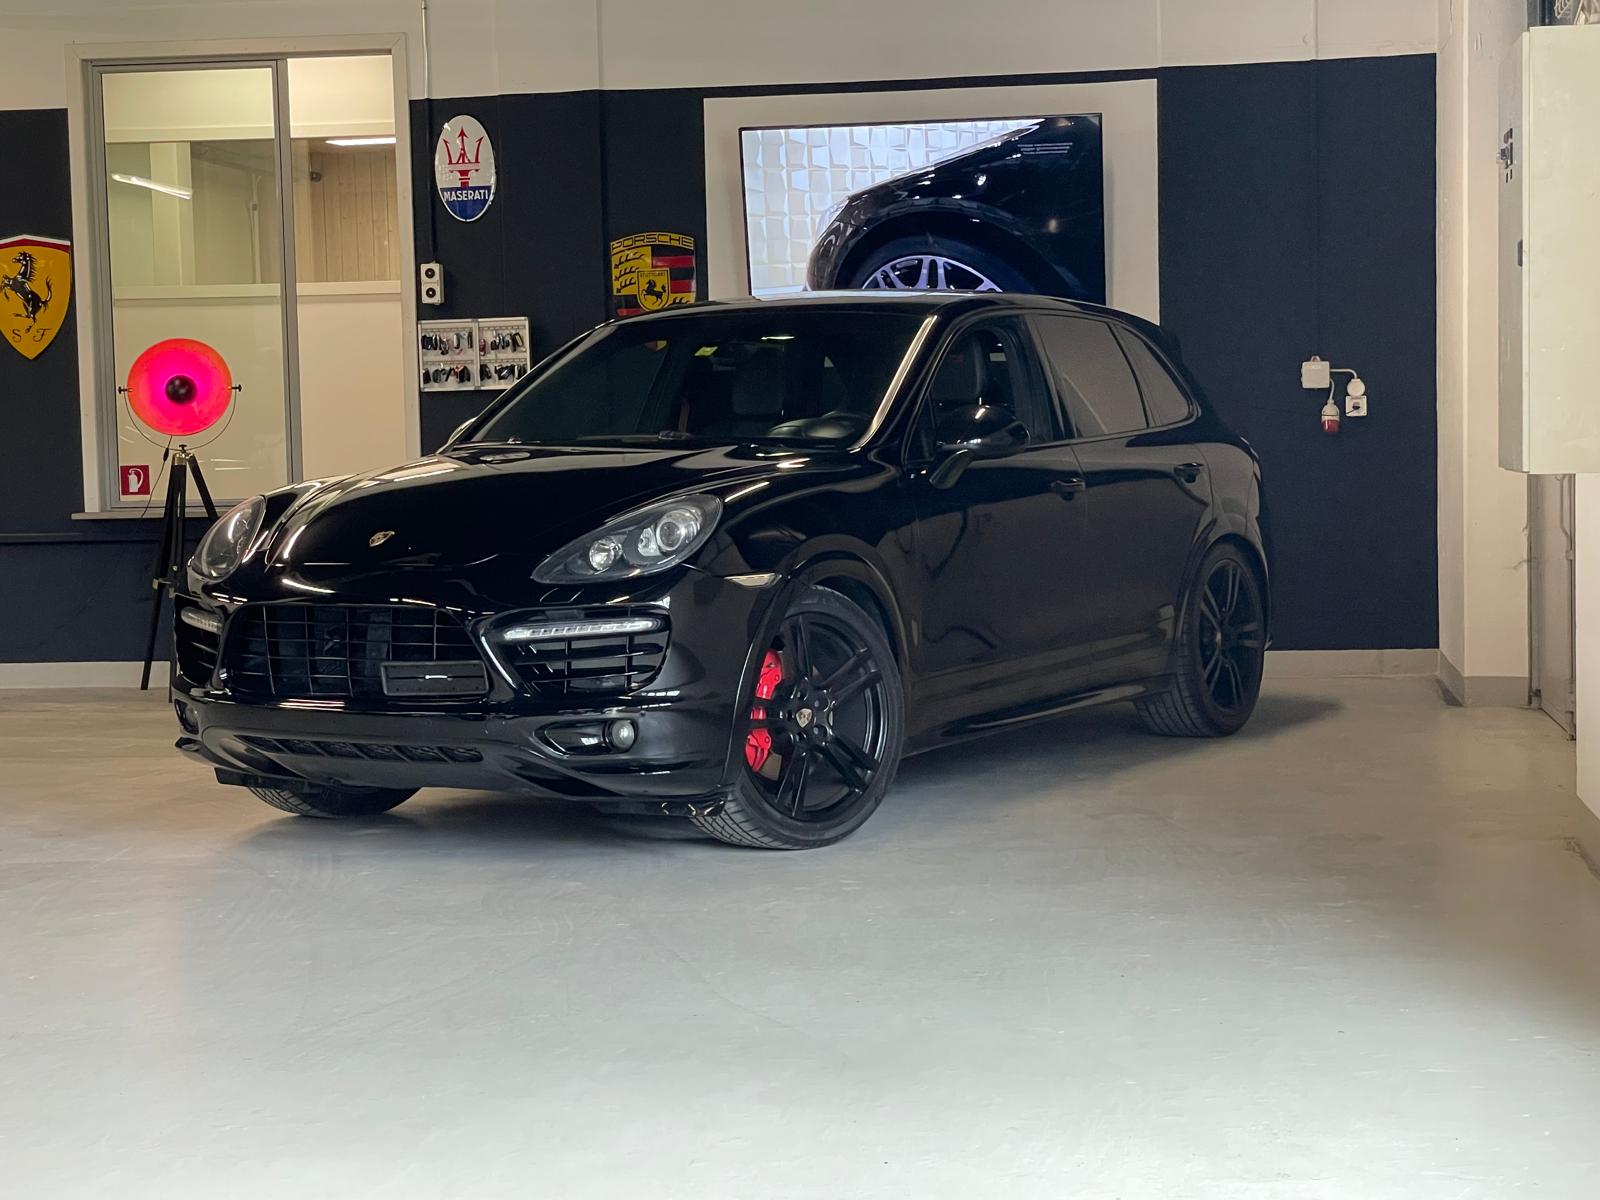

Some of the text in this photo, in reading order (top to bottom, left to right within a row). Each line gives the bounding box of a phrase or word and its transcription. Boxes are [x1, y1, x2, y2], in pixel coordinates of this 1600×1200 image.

[443, 189, 489, 202] MASERATI
[611, 233, 694, 250] PORSCHE
[12, 328, 22, 343] S
